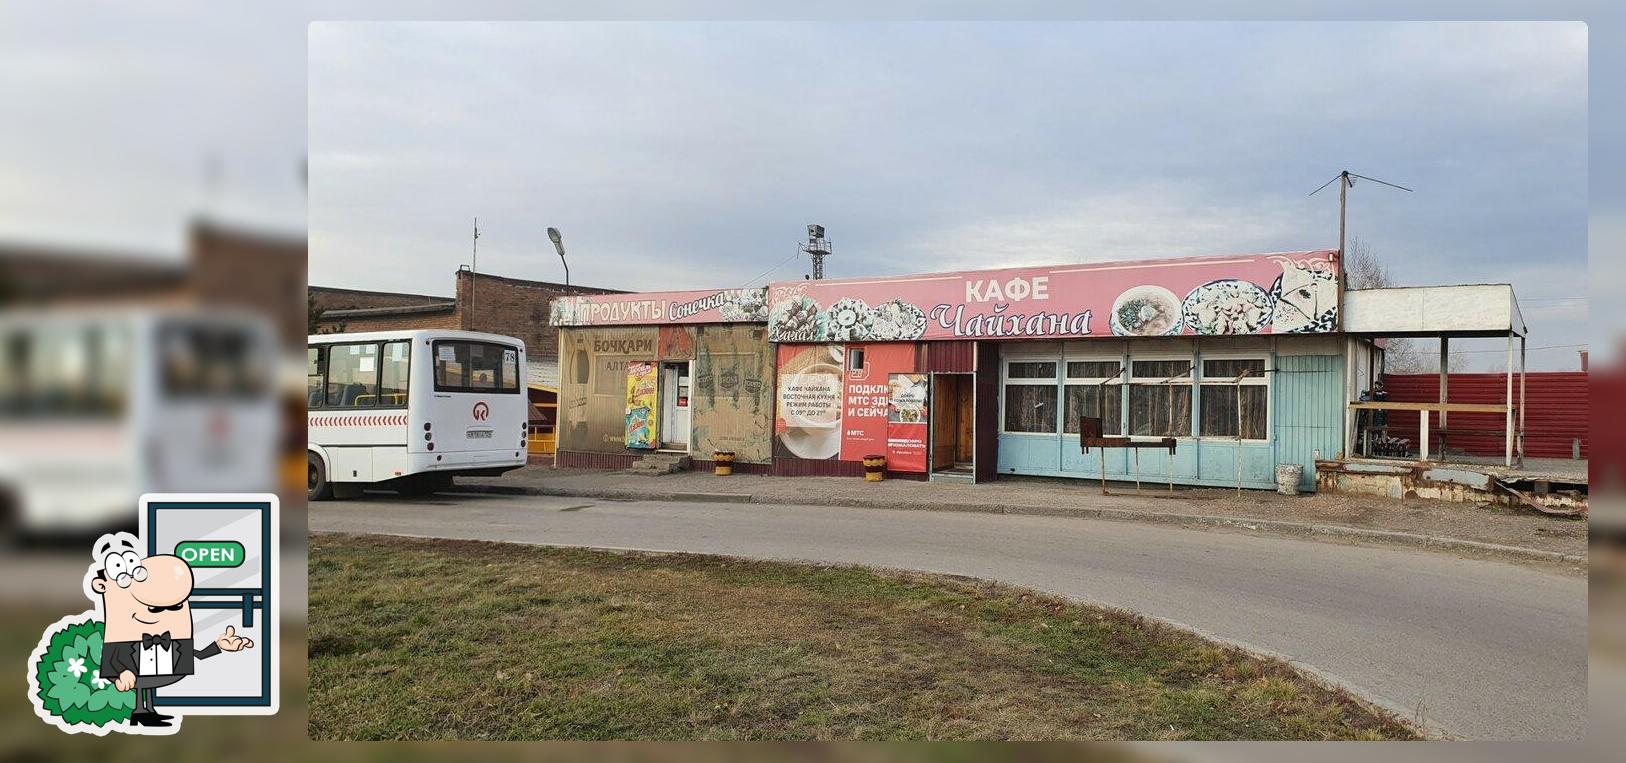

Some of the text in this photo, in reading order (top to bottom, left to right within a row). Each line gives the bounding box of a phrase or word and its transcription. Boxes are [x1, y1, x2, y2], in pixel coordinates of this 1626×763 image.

[965, 276, 1050, 303] КАФЕ
[579, 291, 726, 322] ПРОДУКТЫ Сонечка
[930, 302, 1093, 338] Чайхана
[593, 338, 653, 354] БОЧКАРИ
[505, 352, 515, 362] 78
[848, 396, 870, 405] МТС
[848, 407, 856, 416] И
